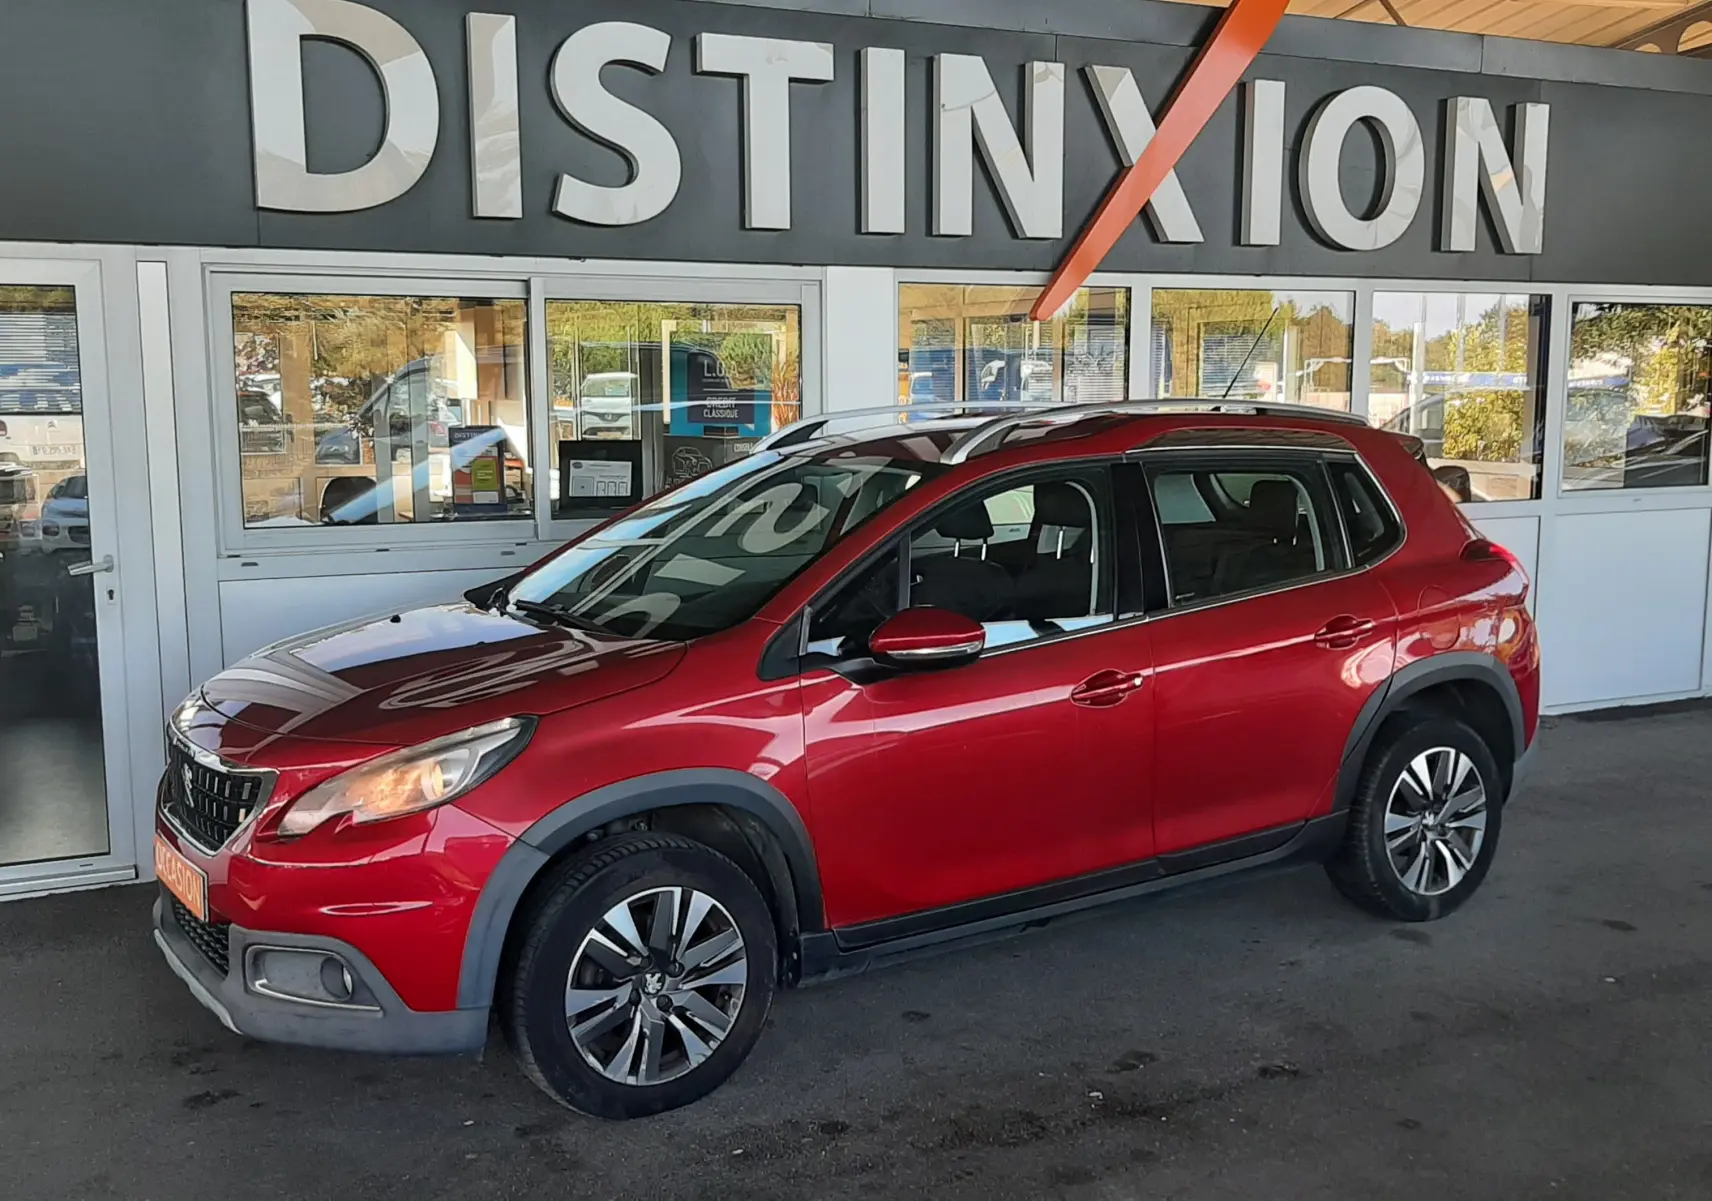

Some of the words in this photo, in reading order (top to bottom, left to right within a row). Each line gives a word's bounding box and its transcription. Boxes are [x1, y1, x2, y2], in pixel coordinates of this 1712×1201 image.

[246, 0, 1550, 255] DISTINXION
[703, 409, 739, 418] CLASSIQUE
[156, 841, 201, 909] OCCASION
